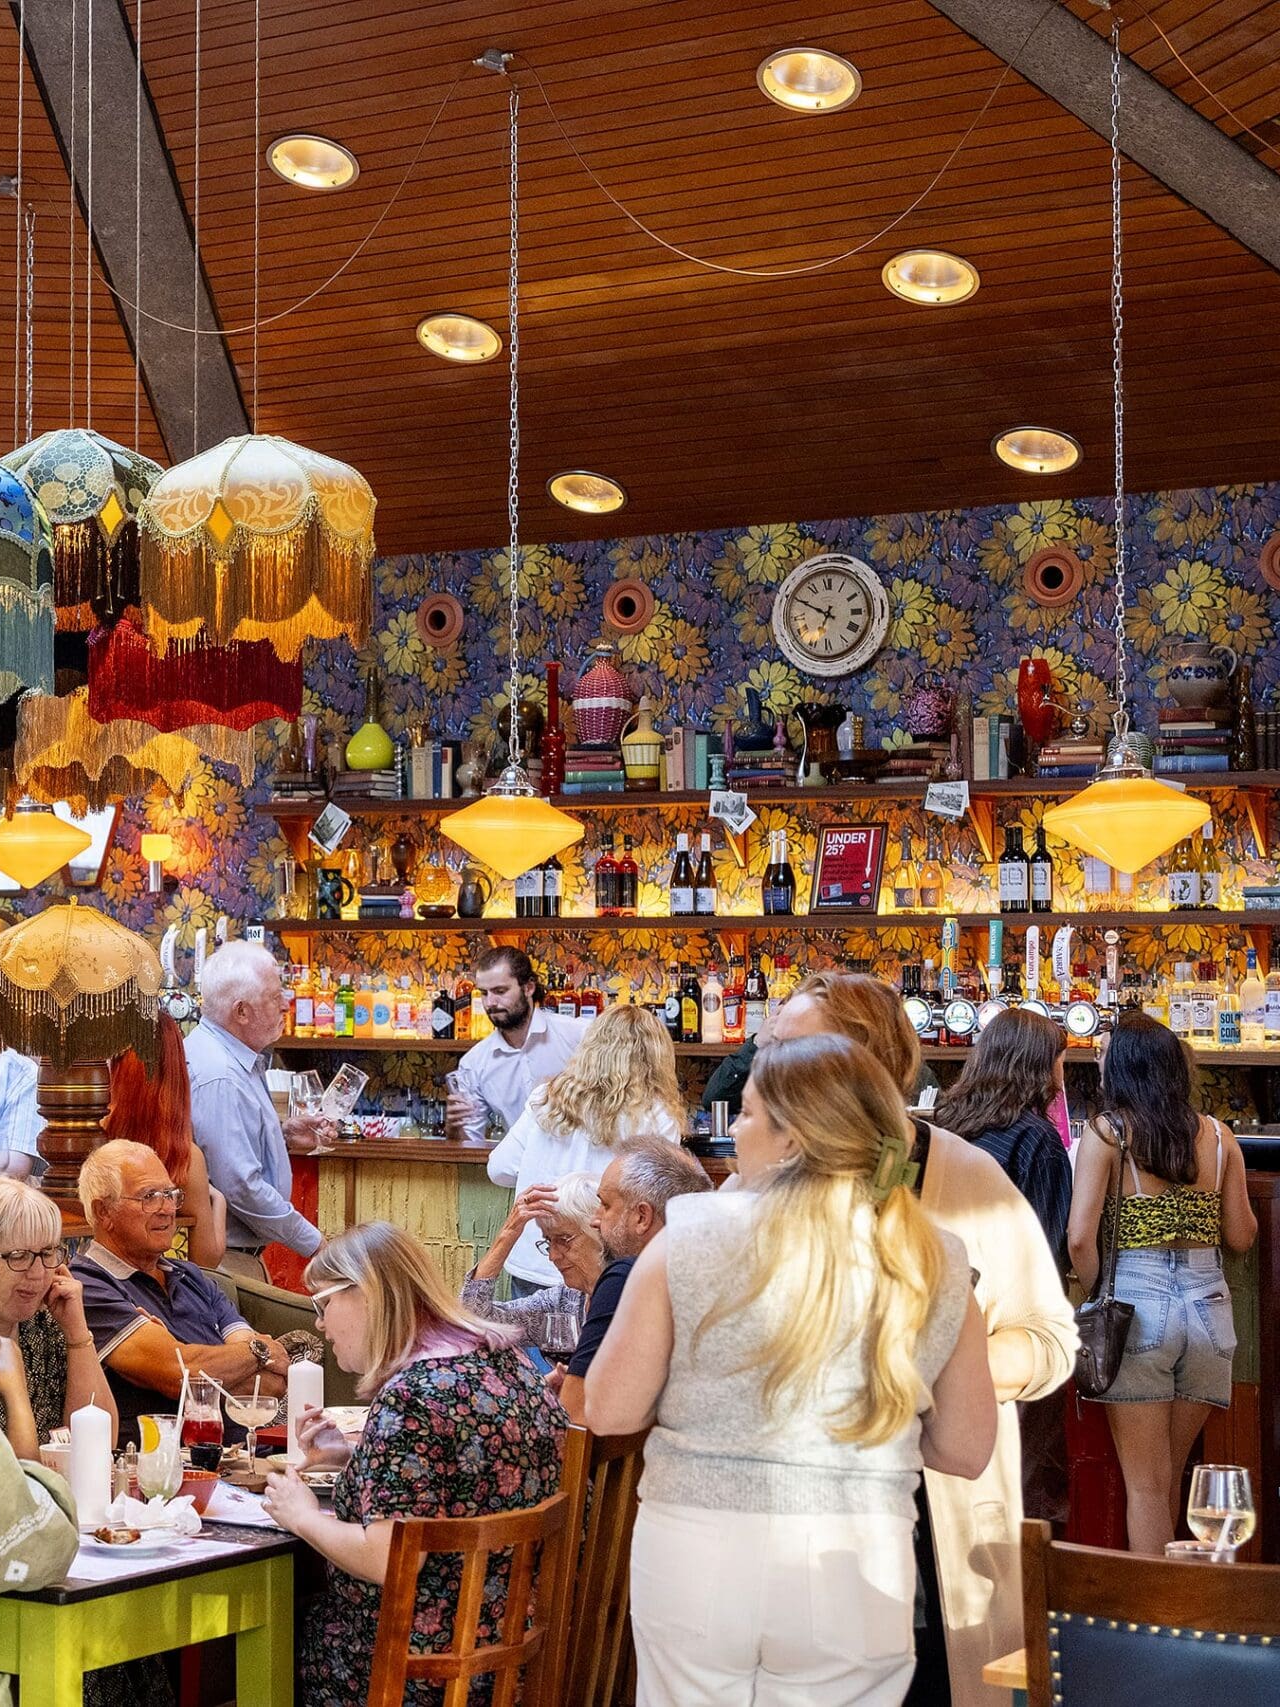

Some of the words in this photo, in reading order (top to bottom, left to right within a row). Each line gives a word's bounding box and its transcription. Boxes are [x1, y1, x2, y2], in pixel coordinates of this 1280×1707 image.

[827, 832, 866, 844] UNDER
[825, 844, 845, 855] 25?
[247, 927, 261, 939] Hof
[1028, 940, 1036, 980] Cruzcampo
